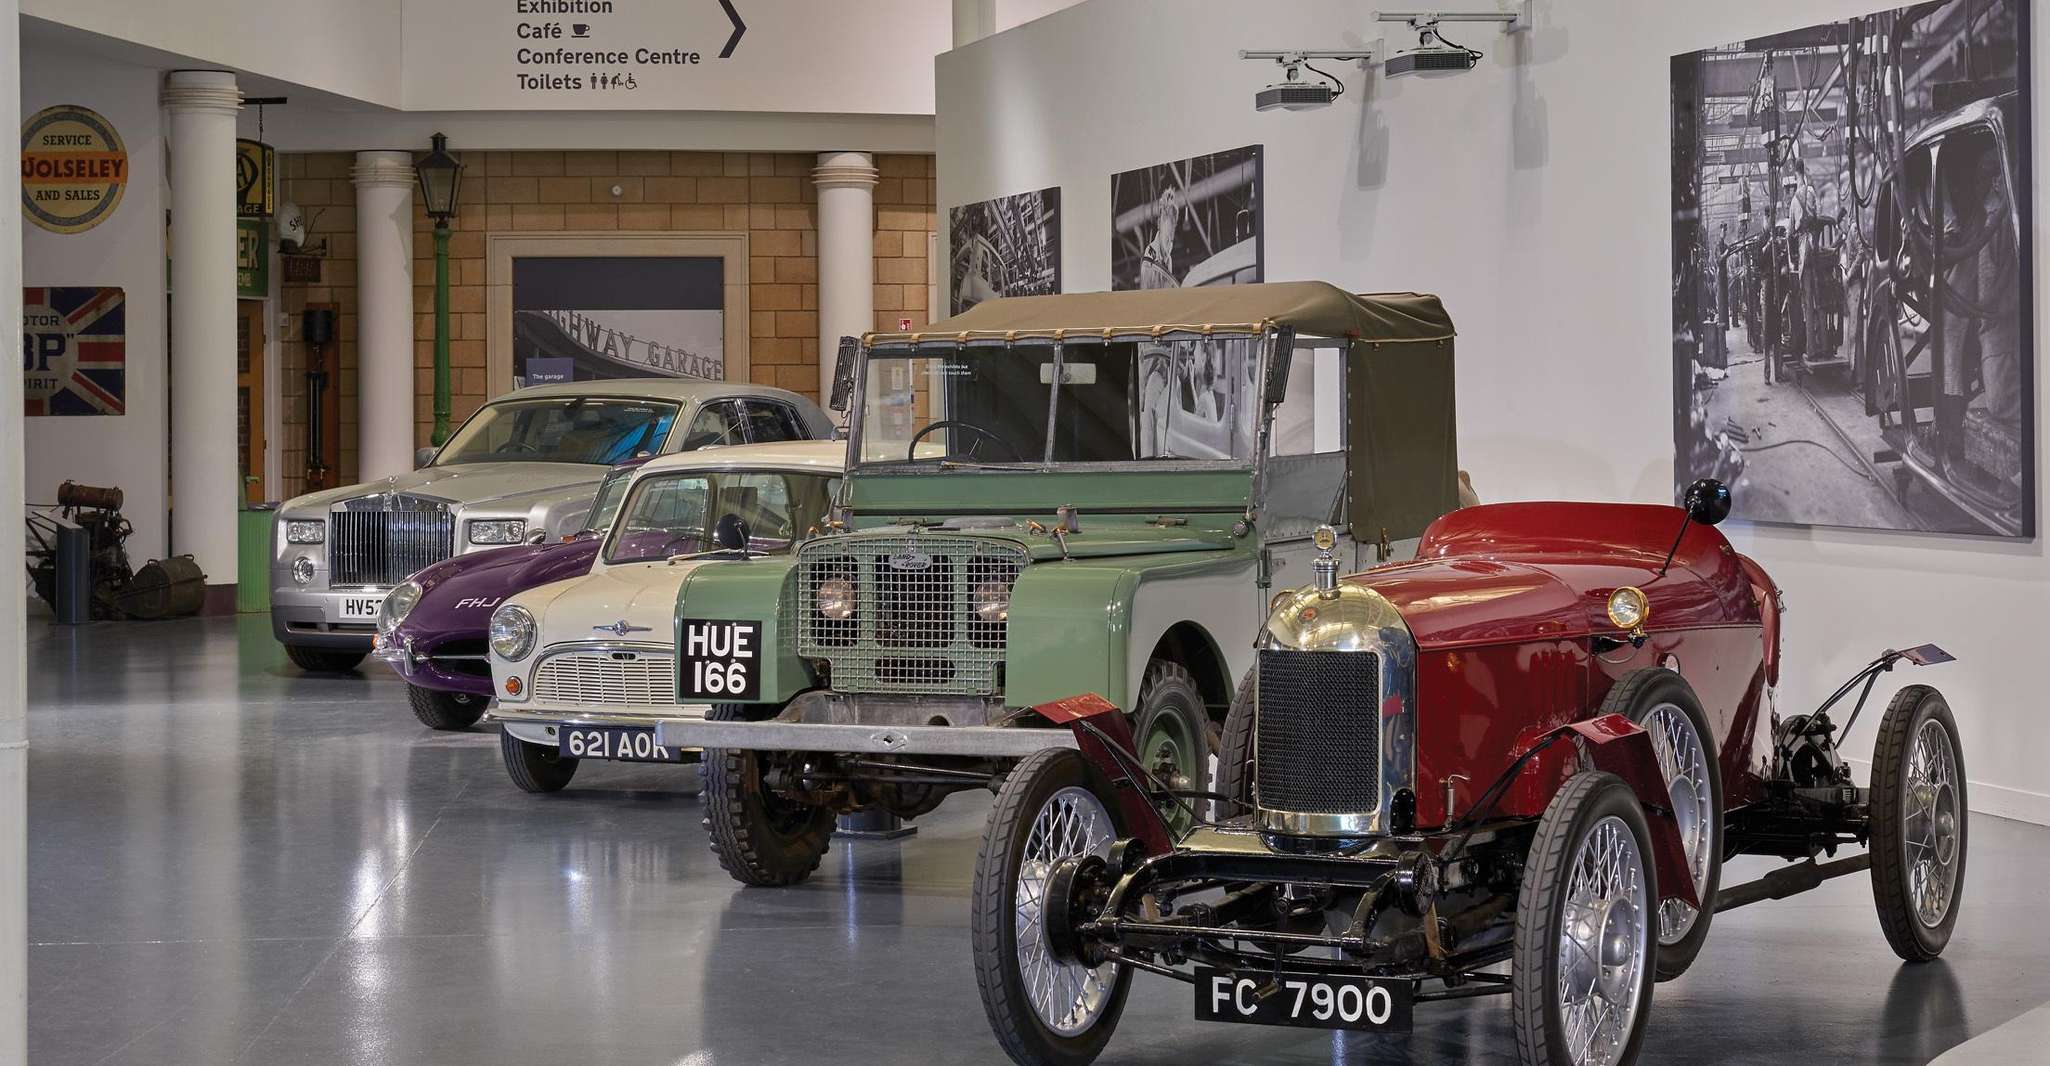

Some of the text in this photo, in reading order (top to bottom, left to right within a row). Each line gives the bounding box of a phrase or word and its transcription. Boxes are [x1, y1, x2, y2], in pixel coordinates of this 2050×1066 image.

[517, 0, 613, 13] Exhibition
[517, 23, 562, 39] Café
[517, 48, 700, 64] Conference Centre
[517, 73, 582, 90] Toilets
[42, 135, 93, 146] SERVICE
[36, 190, 101, 201] AND SALES
[648, 341, 723, 381] GARAGE
[455, 597, 501, 609] FHJ
[688, 624, 754, 658] HUE
[694, 661, 747, 694] 166
[569, 730, 610, 757] 621
[1212, 976, 1392, 1025] FC 7900
